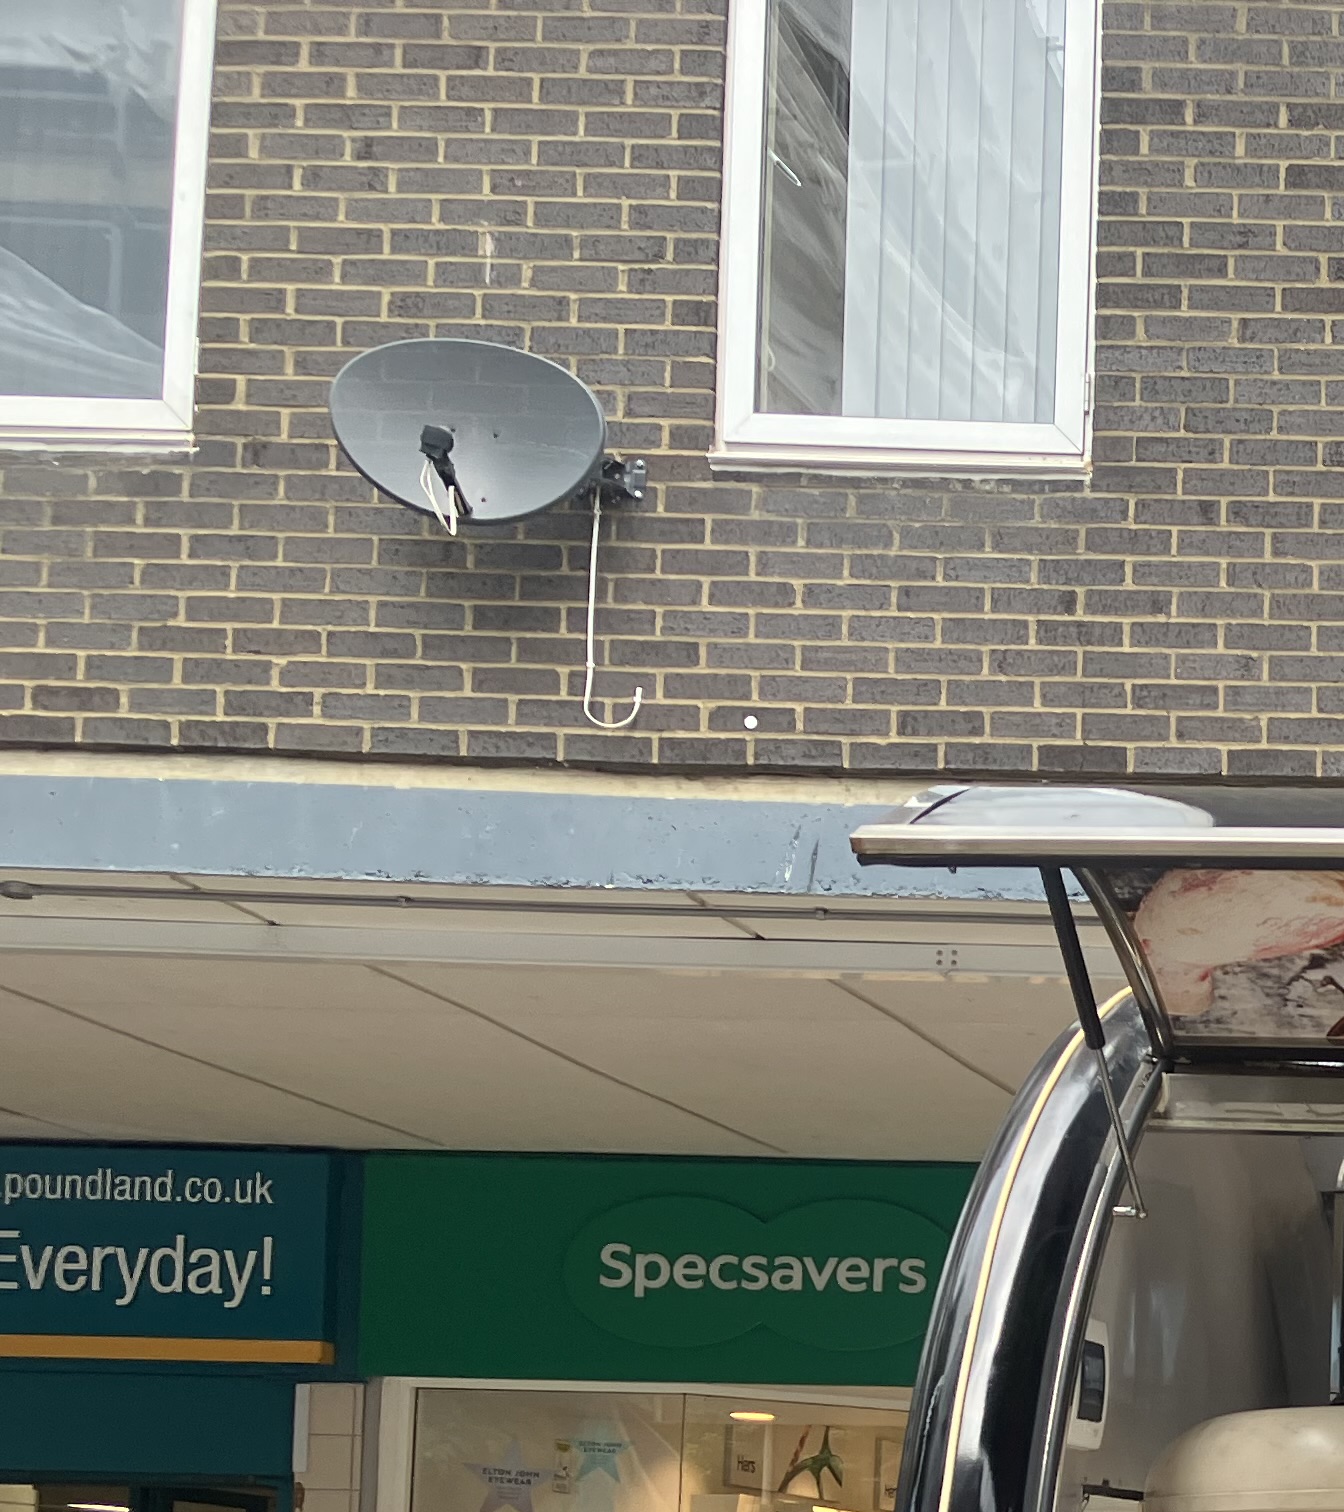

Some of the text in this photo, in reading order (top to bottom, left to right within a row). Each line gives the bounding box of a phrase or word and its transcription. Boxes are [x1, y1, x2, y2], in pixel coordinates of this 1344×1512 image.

[0, 1234, 273, 1308] Everyday!
[600, 1242, 927, 1298] Specsavers
[482, 1467, 540, 1479] ELTON JOHN
[488, 1476, 532, 1486] EYEWEAR
